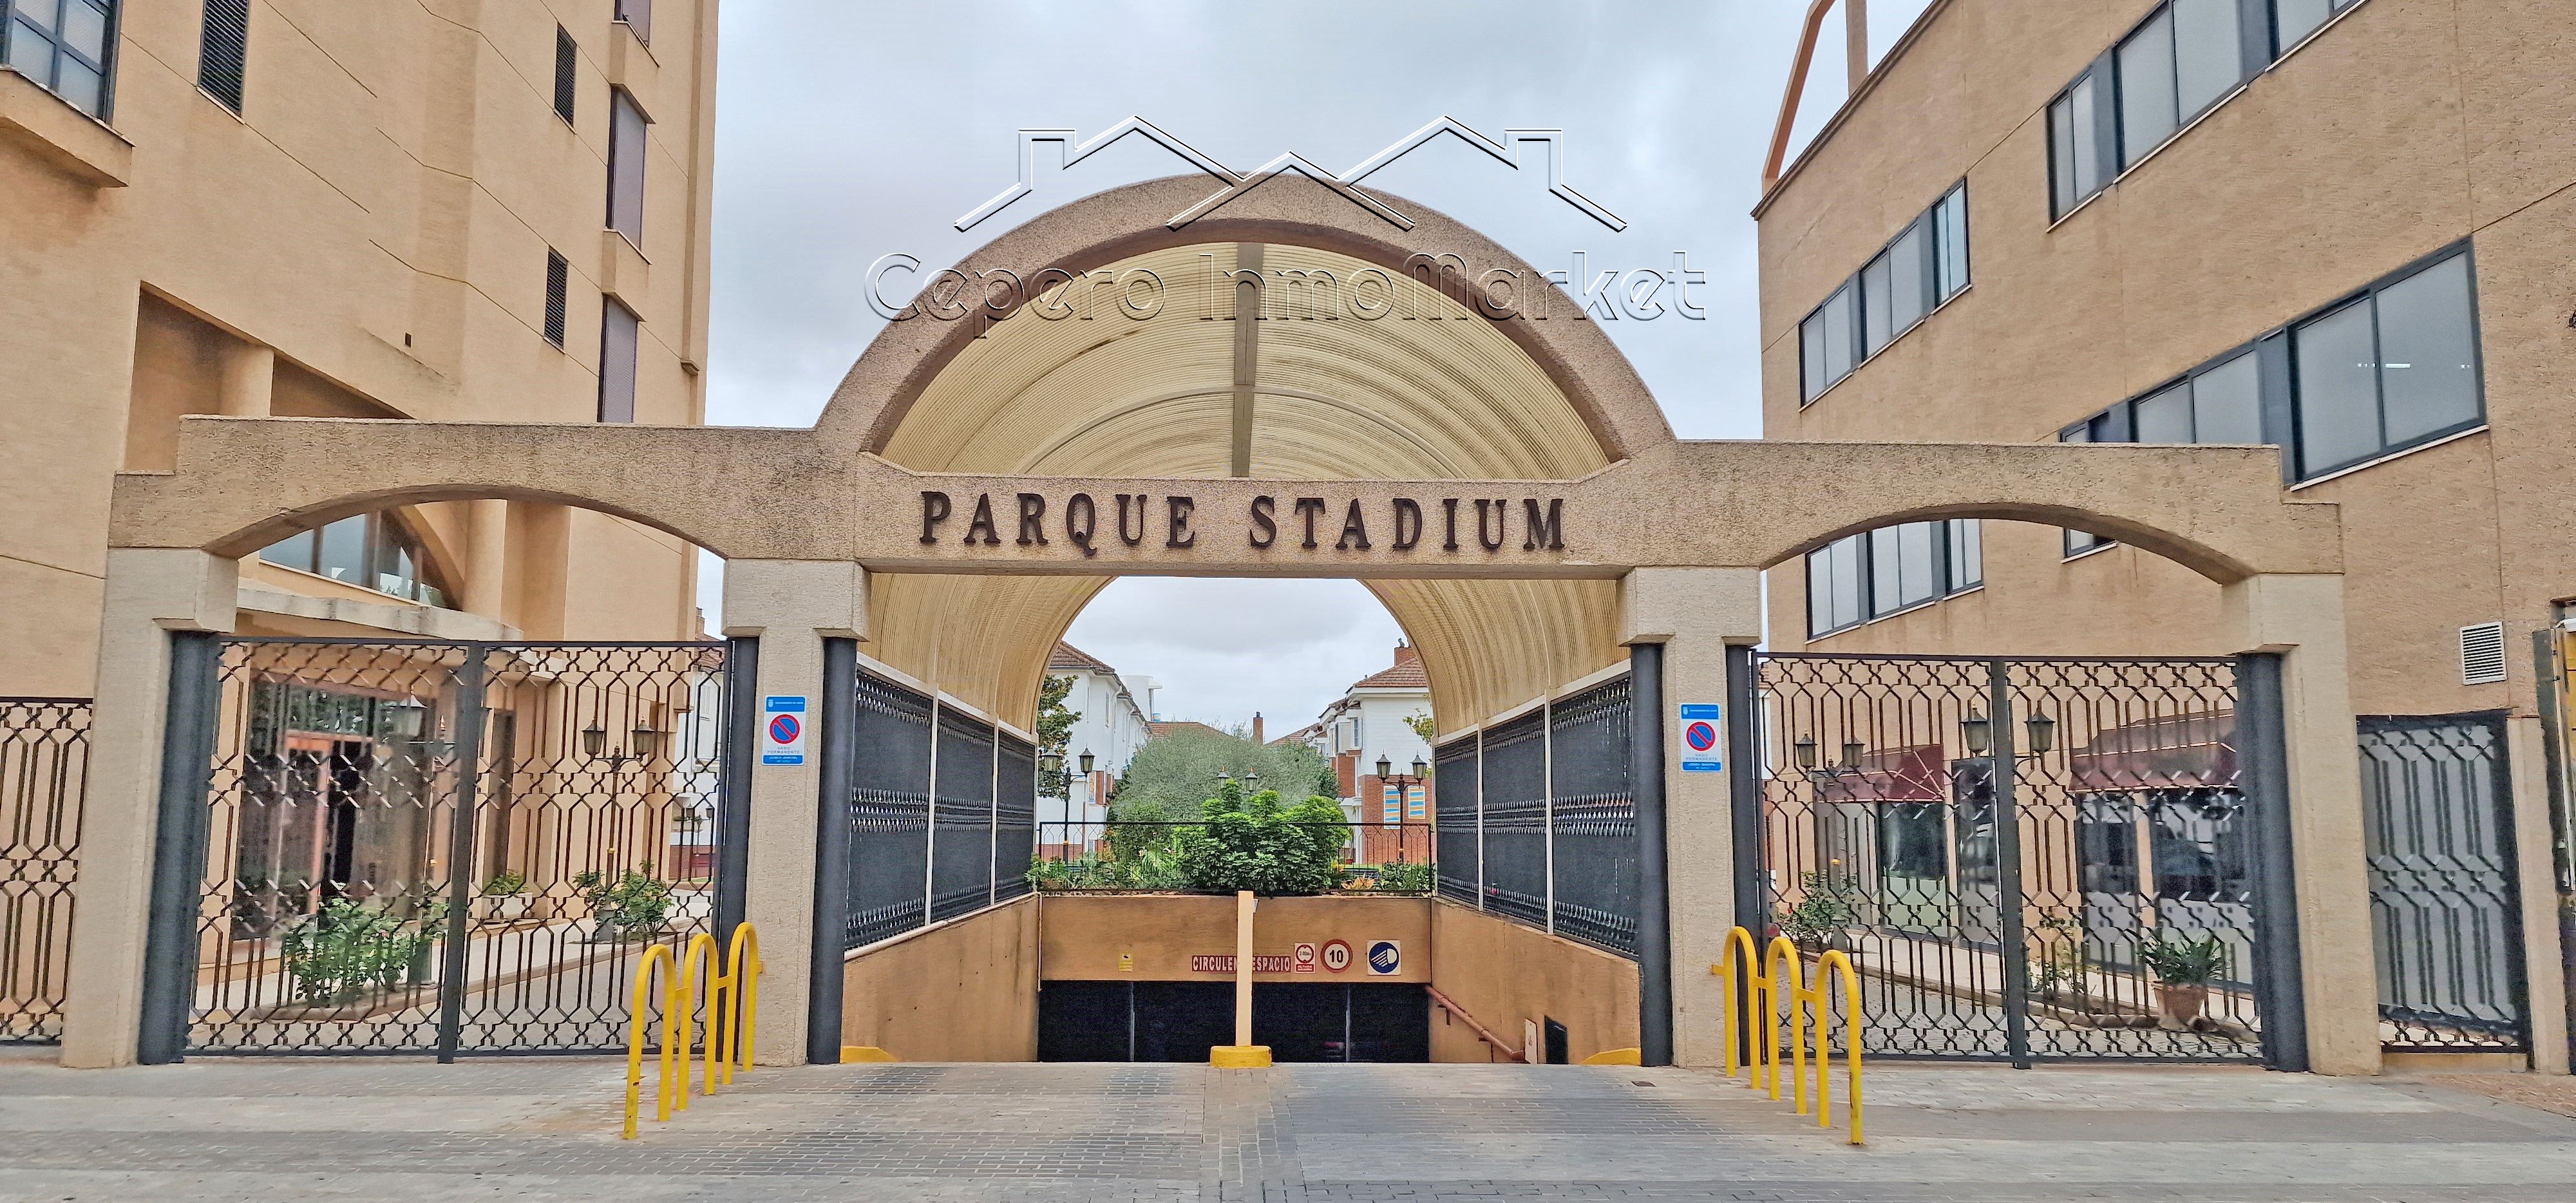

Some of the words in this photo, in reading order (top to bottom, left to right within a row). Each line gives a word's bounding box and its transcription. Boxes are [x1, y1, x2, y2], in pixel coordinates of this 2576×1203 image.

[919, 491, 1196, 557] PARQUE
[1249, 495, 1566, 554] STADIUM
[1253, 956, 1290, 971] ESPACIO
[1329, 949, 1344, 963] 10
